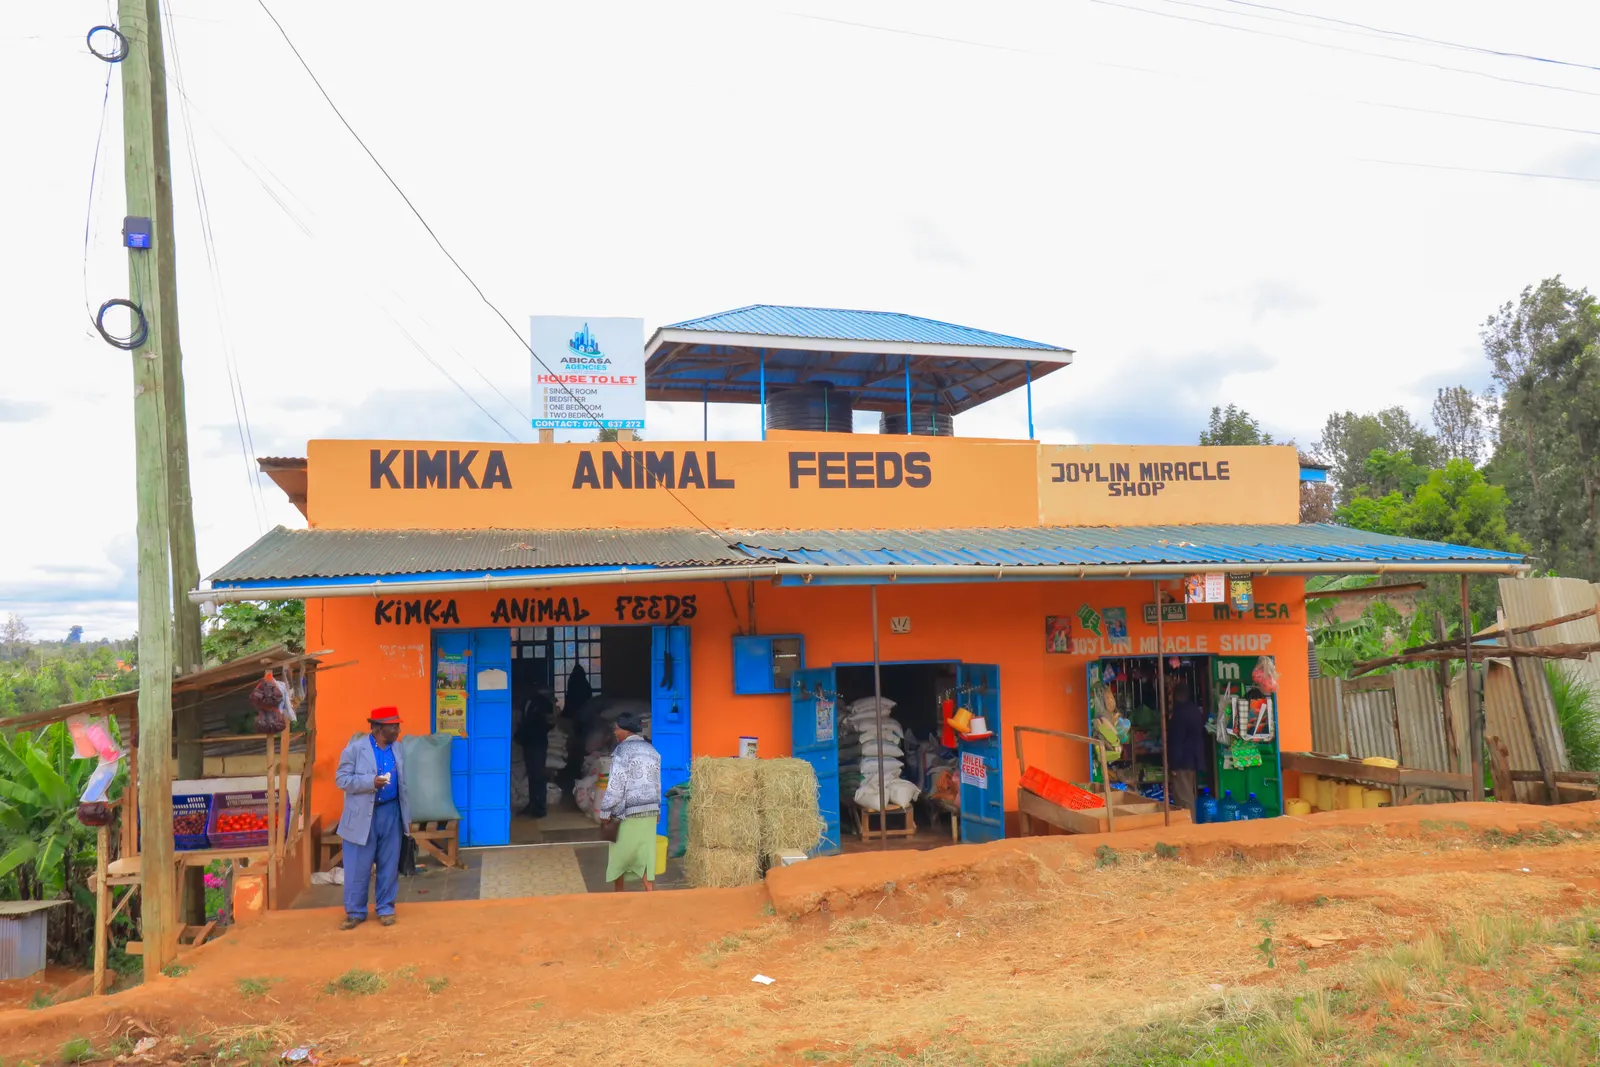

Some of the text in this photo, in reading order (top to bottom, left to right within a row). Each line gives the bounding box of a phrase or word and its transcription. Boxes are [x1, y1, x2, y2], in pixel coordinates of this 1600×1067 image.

[560, 357, 612, 365] ABICASA
[537, 374, 638, 384] HOUSE TO LET
[535, 420, 581, 428] CONTACT:
[369, 449, 932, 489] KIMKA ANIMAL FEEDS
[1050, 460, 1230, 483] JOYLIN MIRACLE
[1107, 481, 1165, 497] SHOP
[614, 594, 698, 621] FEEDS
[1219, 633, 1272, 651] SHOP
[962, 763, 985, 778] FEEDS
